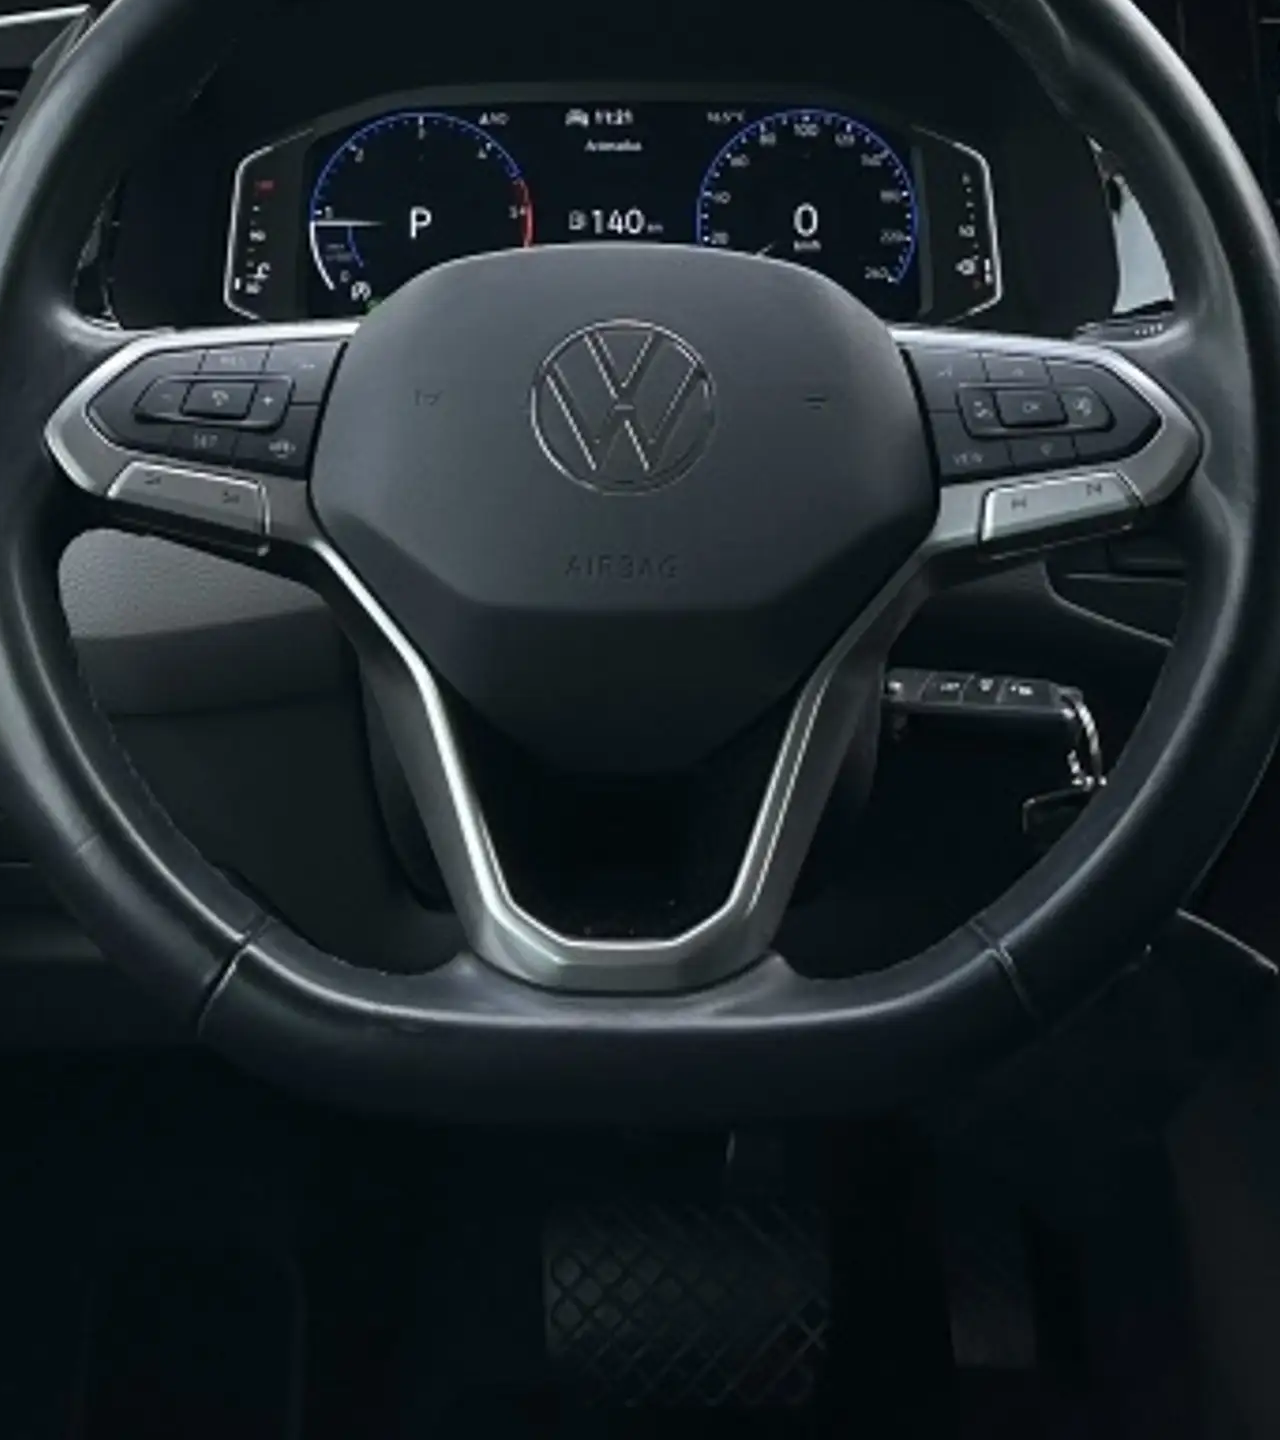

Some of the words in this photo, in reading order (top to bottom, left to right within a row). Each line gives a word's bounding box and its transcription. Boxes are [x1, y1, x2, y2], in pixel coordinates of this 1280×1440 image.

[409, 206, 433, 239] P
[591, 209, 646, 235] 140
[793, 202, 819, 237] 0
[565, 553, 678, 579] AIRBAG
